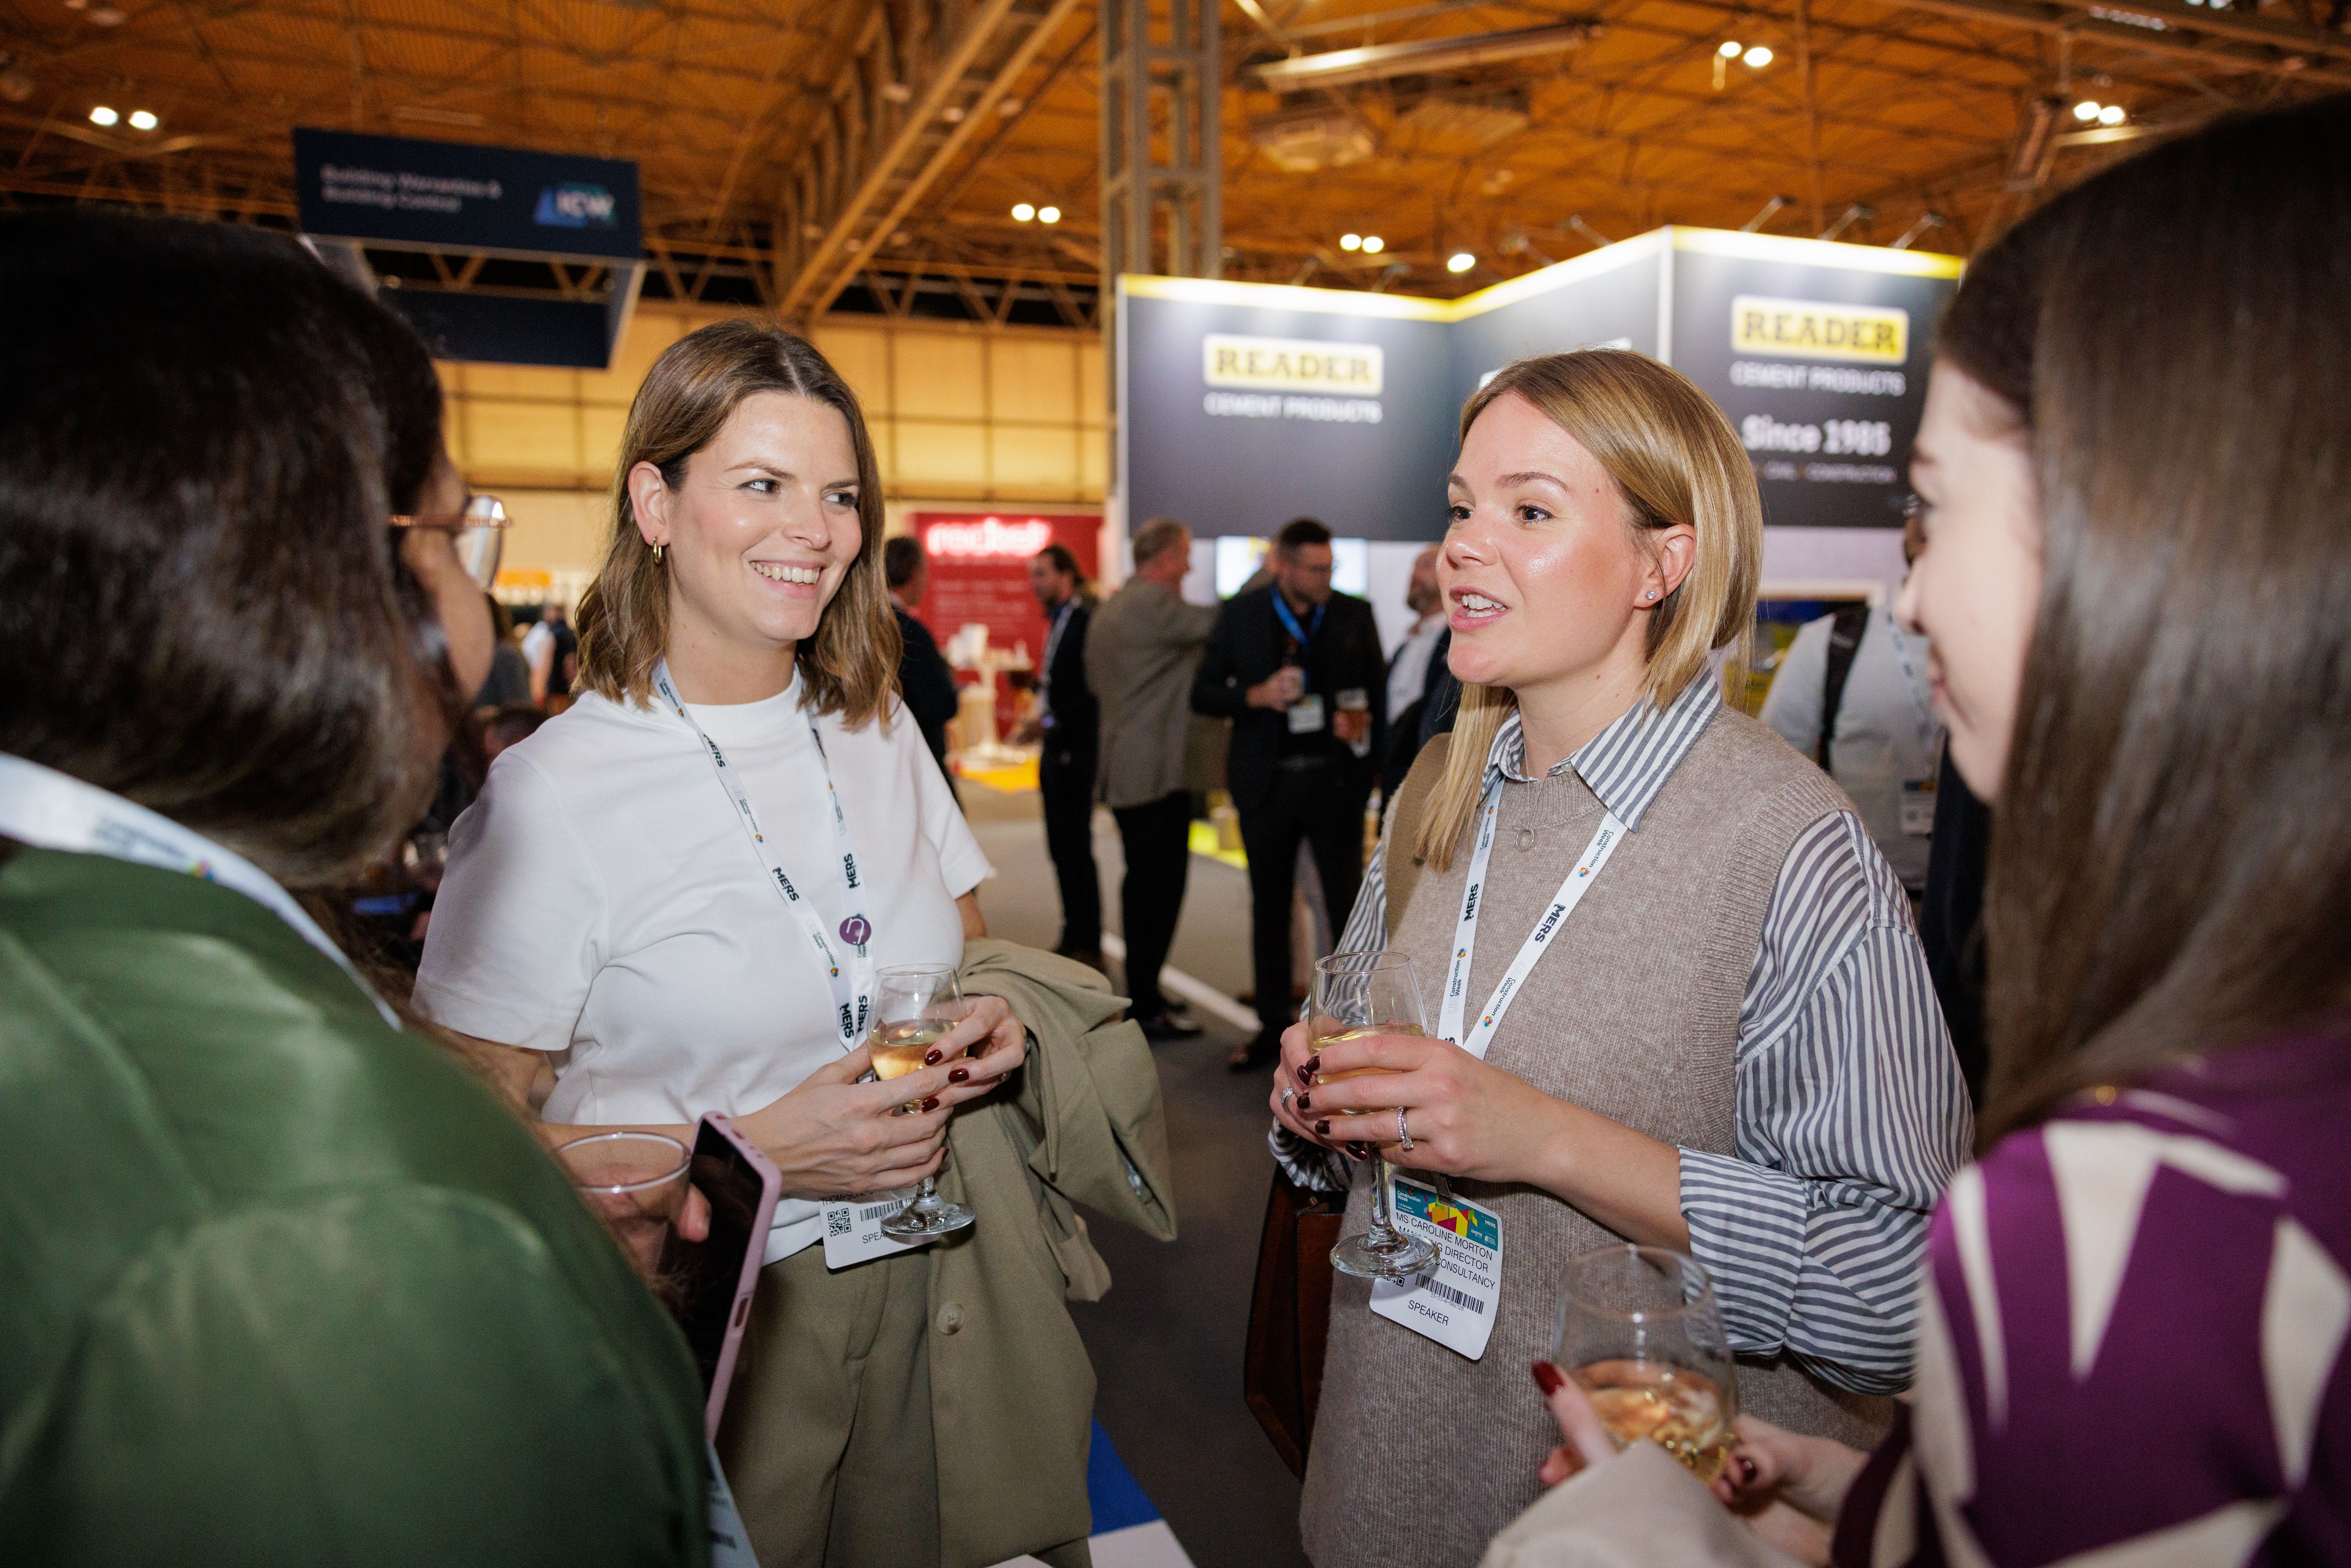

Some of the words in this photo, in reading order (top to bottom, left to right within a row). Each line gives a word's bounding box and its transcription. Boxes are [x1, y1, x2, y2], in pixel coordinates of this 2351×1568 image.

[1743, 310, 1895, 353] READER
[1215, 348, 1372, 384] READER
[1730, 361, 1807, 389] CEMENT
[1808, 366, 1906, 397] PRODUCTS
[1203, 391, 1282, 418] CEMENT
[1283, 395, 1383, 423] PRODUCTS
[1742, 414, 1822, 453] Since
[1480, 816, 1491, 850] Construction
[1588, 831, 1614, 867] Construction
[1596, 829, 1609, 846] Week
[773, 867, 799, 901] MERS
[844, 853, 860, 889] MERS
[1464, 883, 1479, 922] MERS
[813, 933, 823, 949] Week
[1535, 903, 1566, 943] MERS
[817, 932, 835, 965] Construction
[1450, 960, 1461, 997] Construction
[1499, 977, 1512, 994] Week
[857, 995, 868, 1033] MERS
[1491, 979, 1516, 1016] Construction
[840, 1002, 854, 1038] MERS
[1397, 1190, 1420, 1203] Construction
[1396, 1213, 1409, 1223] MS
[1411, 1218, 1452, 1243] CAROLINE
[1455, 1237, 1492, 1261] MORTON
[1485, 1220, 1496, 1228] MERS
[1436, 1257, 1495, 1290] CONSULTANCY
[1445, 1246, 1488, 1273] DIRECTOR
[1408, 1300, 1449, 1325] SPEAKER
